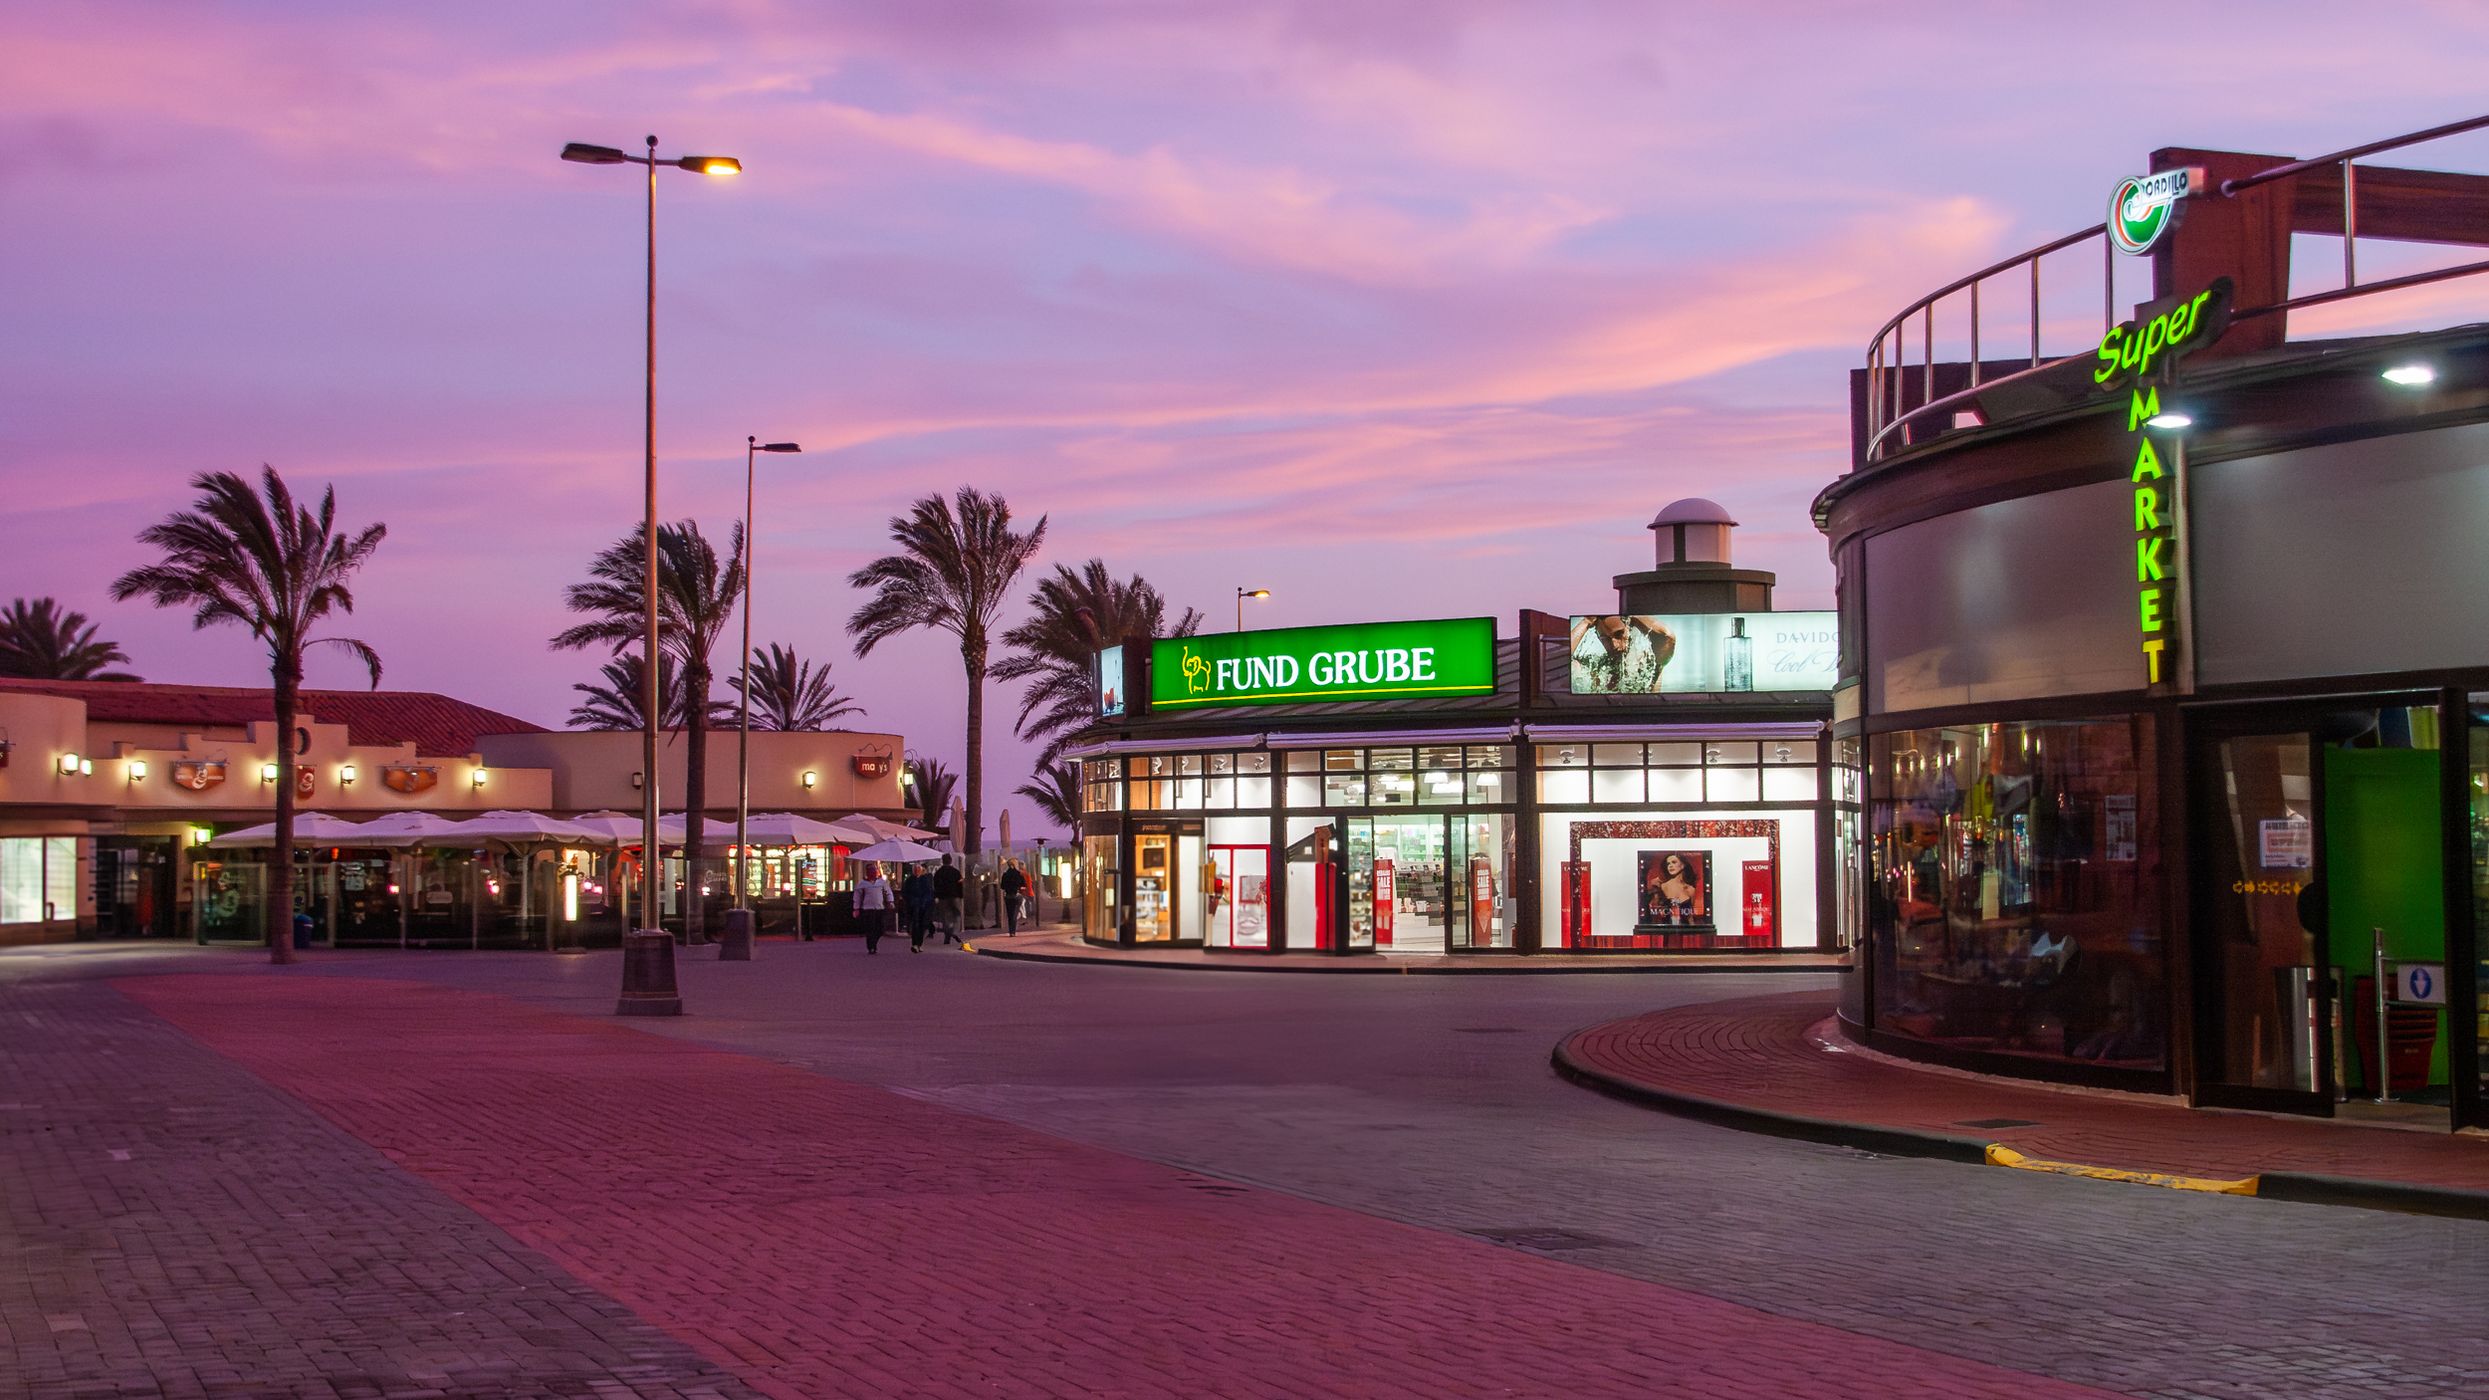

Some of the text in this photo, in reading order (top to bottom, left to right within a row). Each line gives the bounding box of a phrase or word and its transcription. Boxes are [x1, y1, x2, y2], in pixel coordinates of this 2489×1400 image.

[2094, 288, 2212, 383] Super
[2127, 387, 2166, 685] MARKET
[1216, 647, 1436, 691] FUND GRUBE
[862, 762, 887, 773] may's
